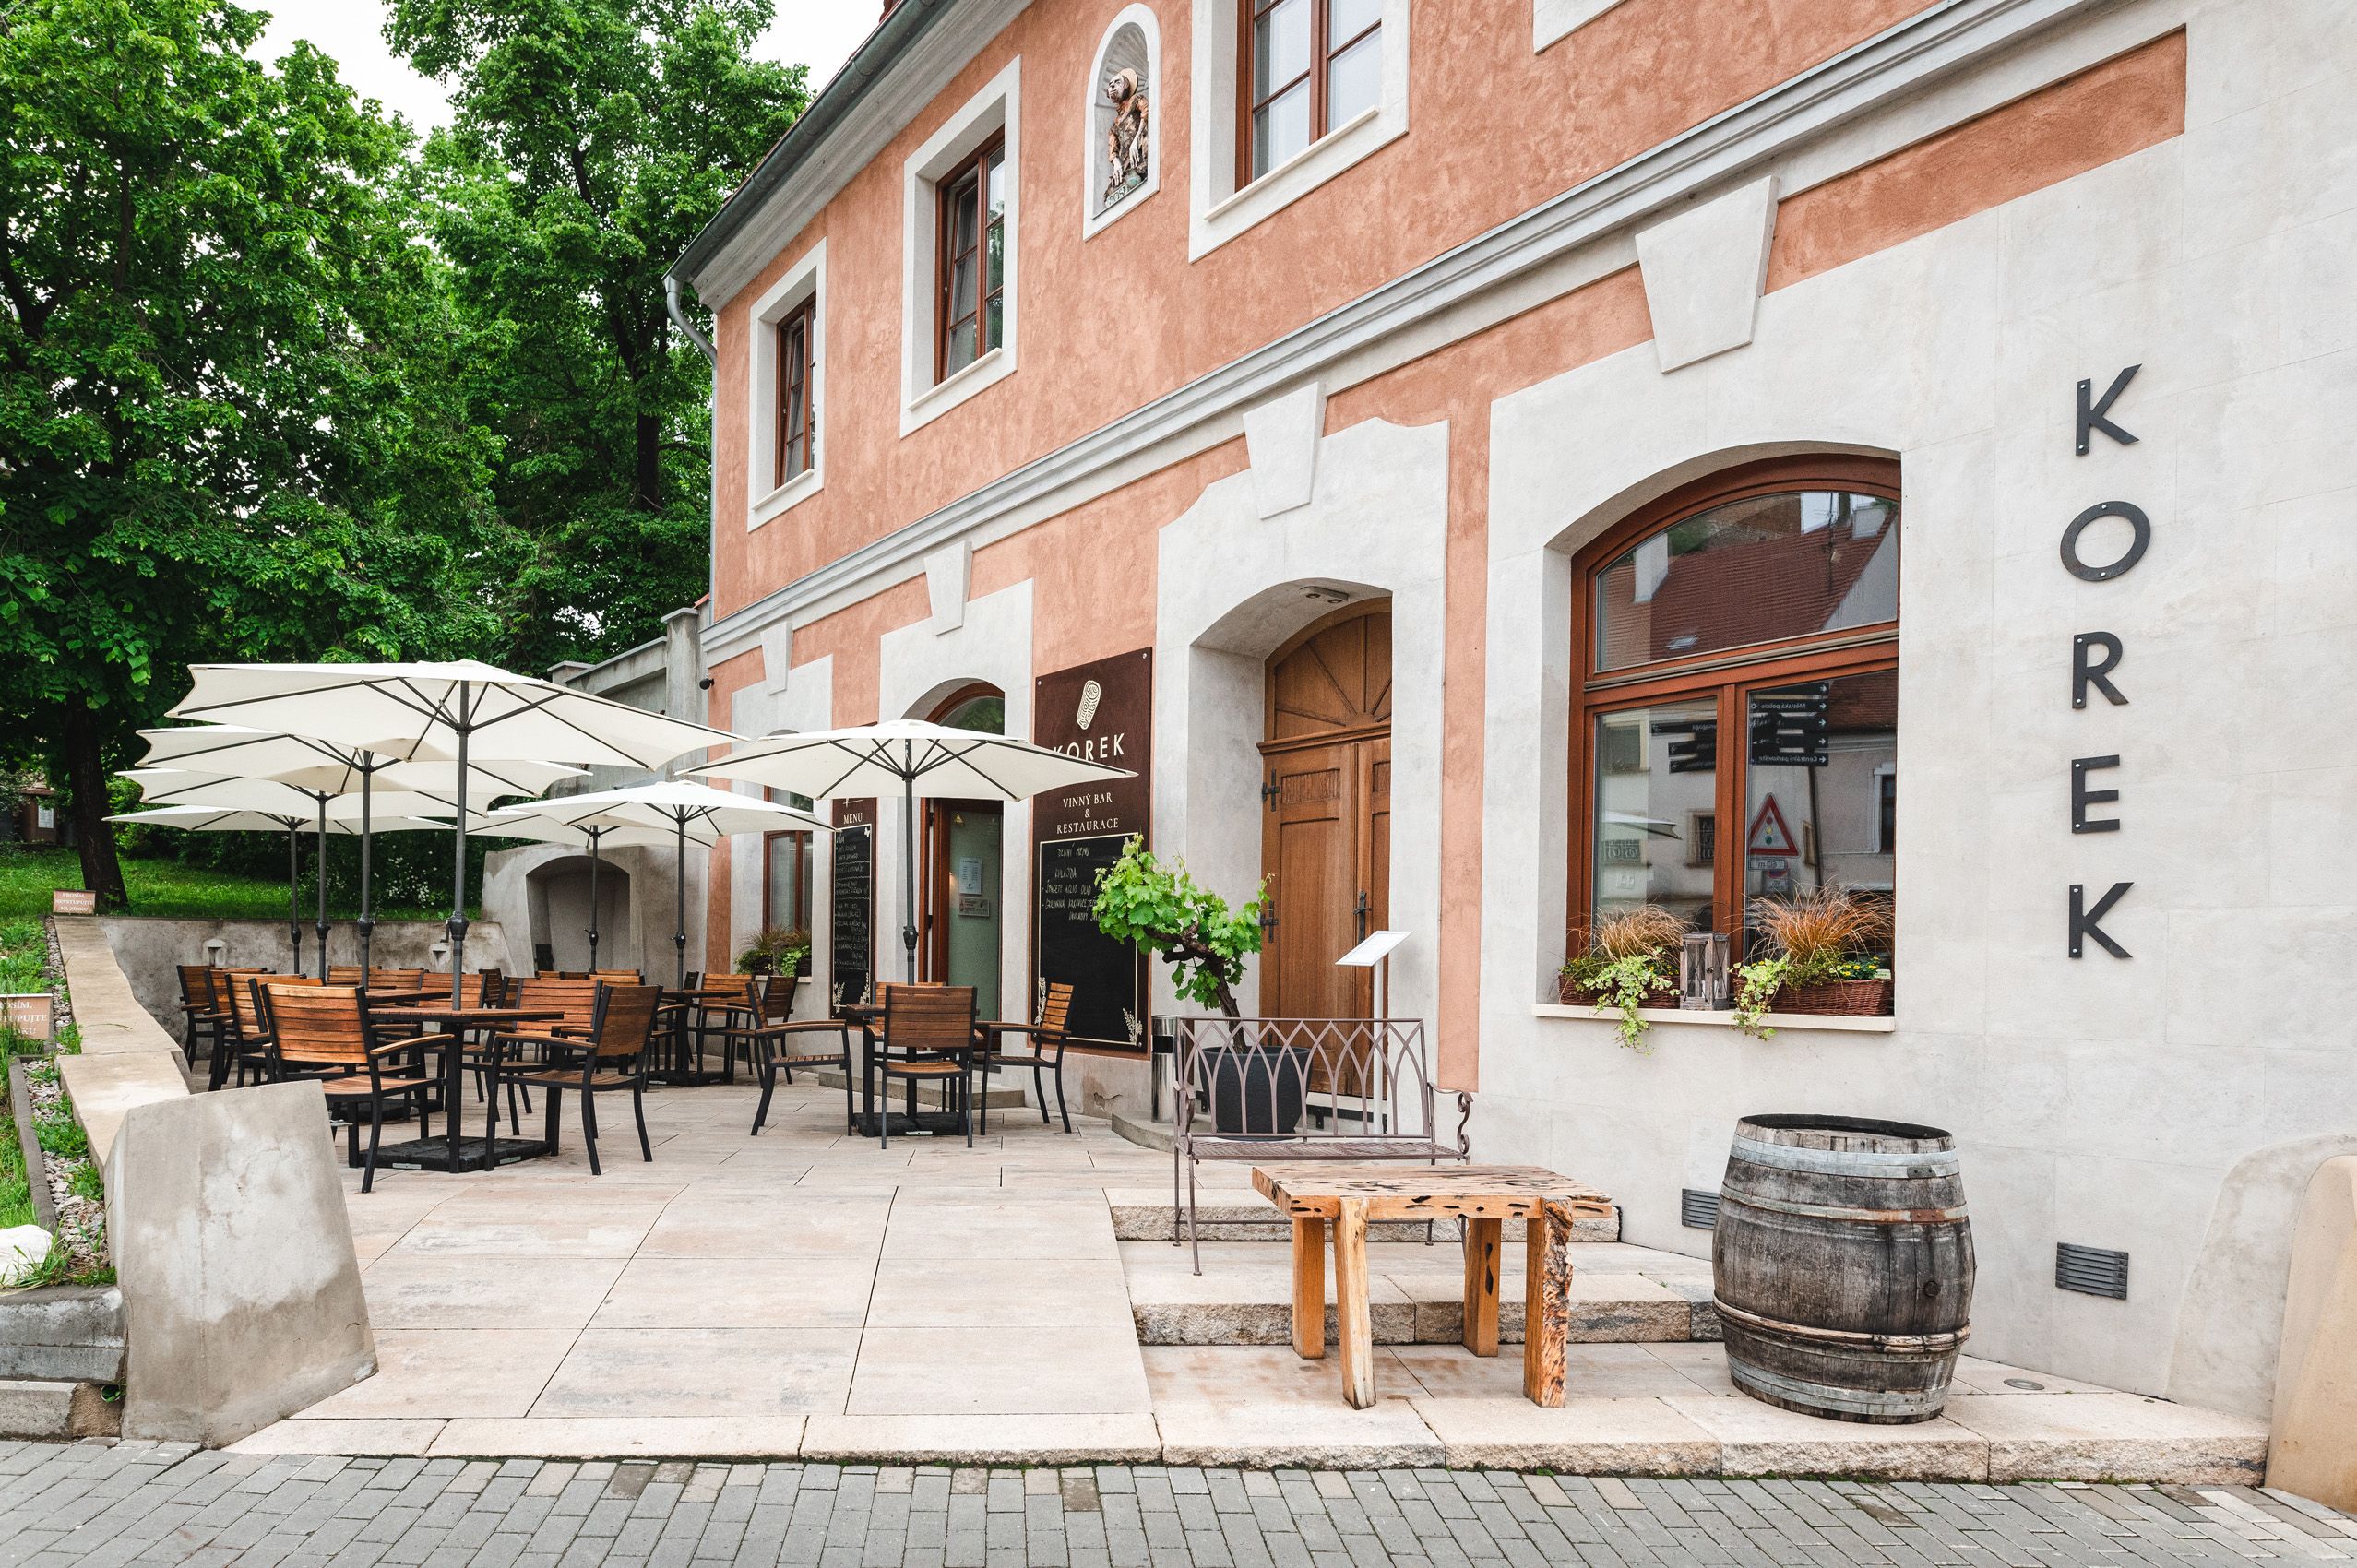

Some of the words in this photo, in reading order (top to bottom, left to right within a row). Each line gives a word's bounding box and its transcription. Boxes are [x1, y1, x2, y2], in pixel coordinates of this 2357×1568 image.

[2060, 363, 2151, 958] KOREK
[1063, 793, 1091, 808] VINNÝ
[1094, 792, 1113, 805] BAR
[843, 812, 863, 825] MENU
[1084, 808, 1090, 818] &
[1056, 817, 1119, 835] RESTAURACE
